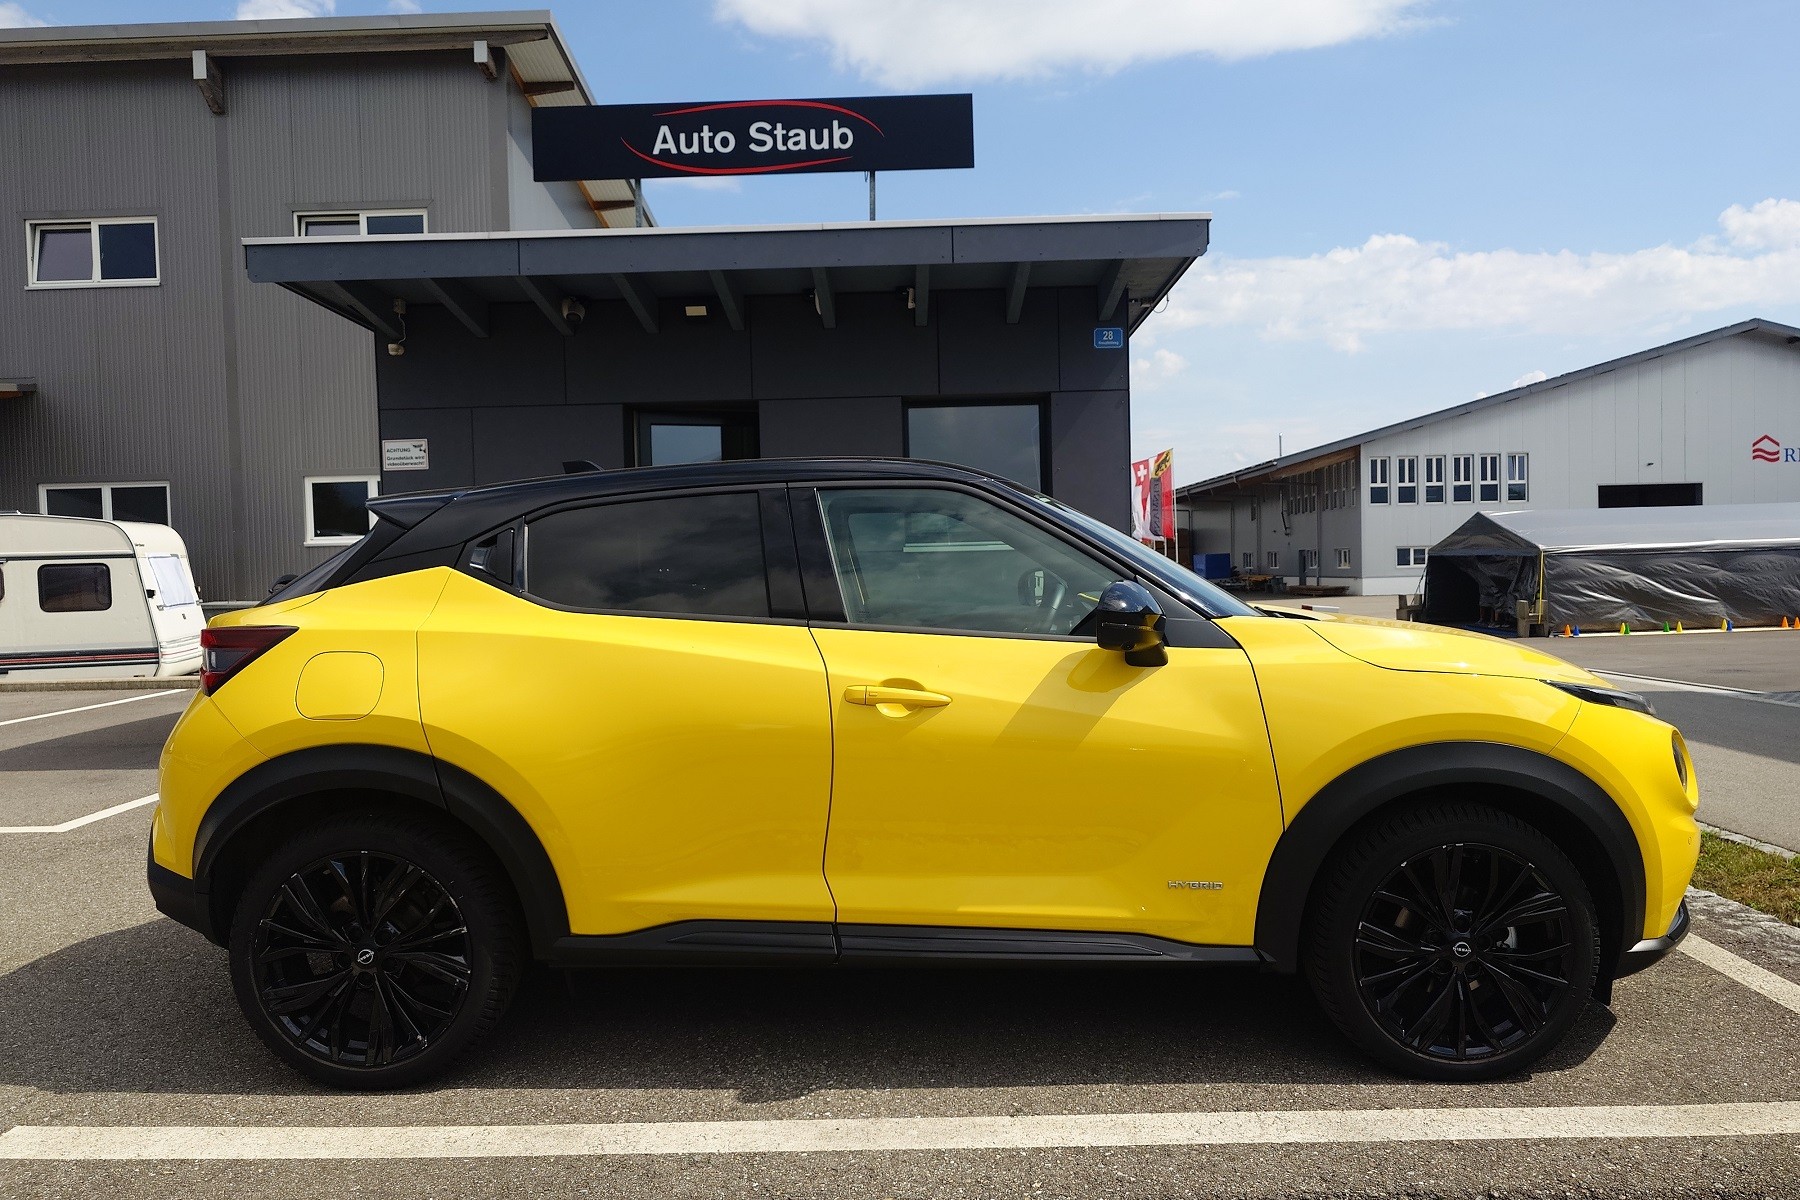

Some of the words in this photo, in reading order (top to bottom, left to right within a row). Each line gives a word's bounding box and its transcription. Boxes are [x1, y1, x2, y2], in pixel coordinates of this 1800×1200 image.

[652, 124, 736, 155] Auto
[748, 120, 854, 153] Staub
[1102, 330, 1114, 341] 28
[1167, 880, 1224, 890] HYBRID
